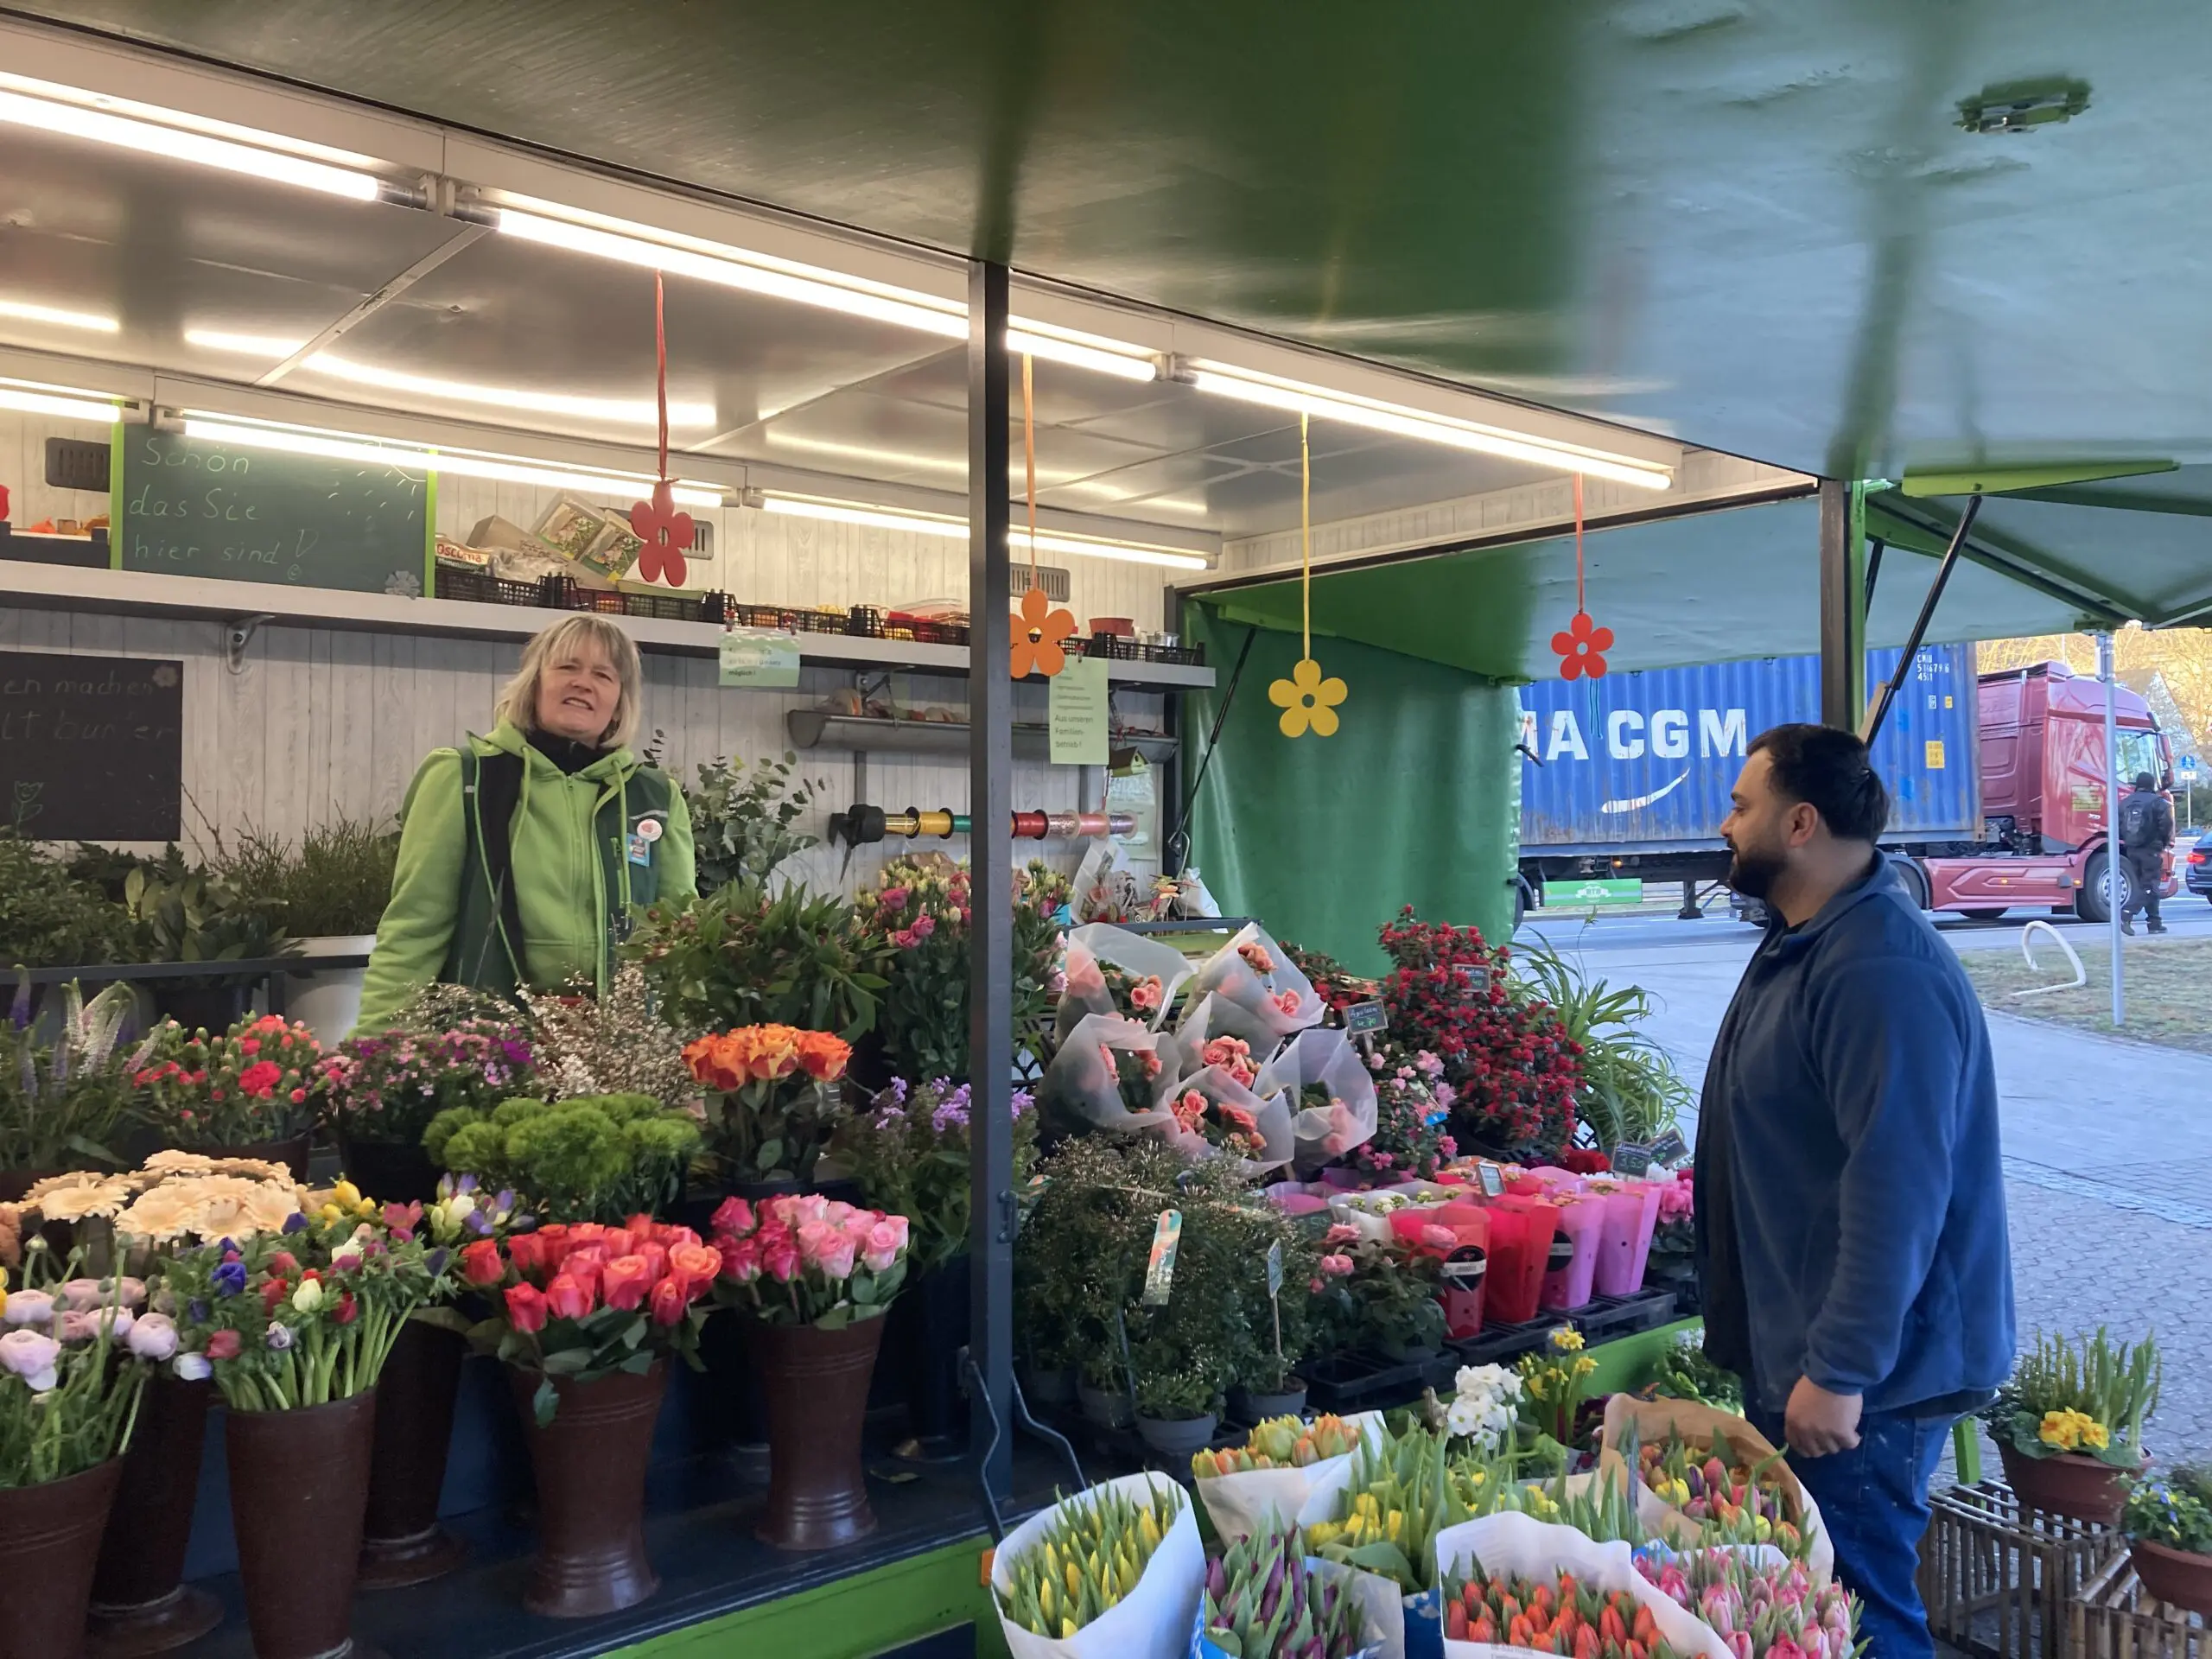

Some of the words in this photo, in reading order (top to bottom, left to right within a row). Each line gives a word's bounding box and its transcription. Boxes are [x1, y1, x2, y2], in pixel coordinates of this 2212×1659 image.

[142, 437, 249, 474] Schön
[130, 484, 188, 518] das
[203, 487, 260, 521] Sie
[134, 533, 201, 561] hier
[220, 541, 281, 565] sind
[54, 709, 175, 740] buner
[1608, 709, 1746, 760] CGM
